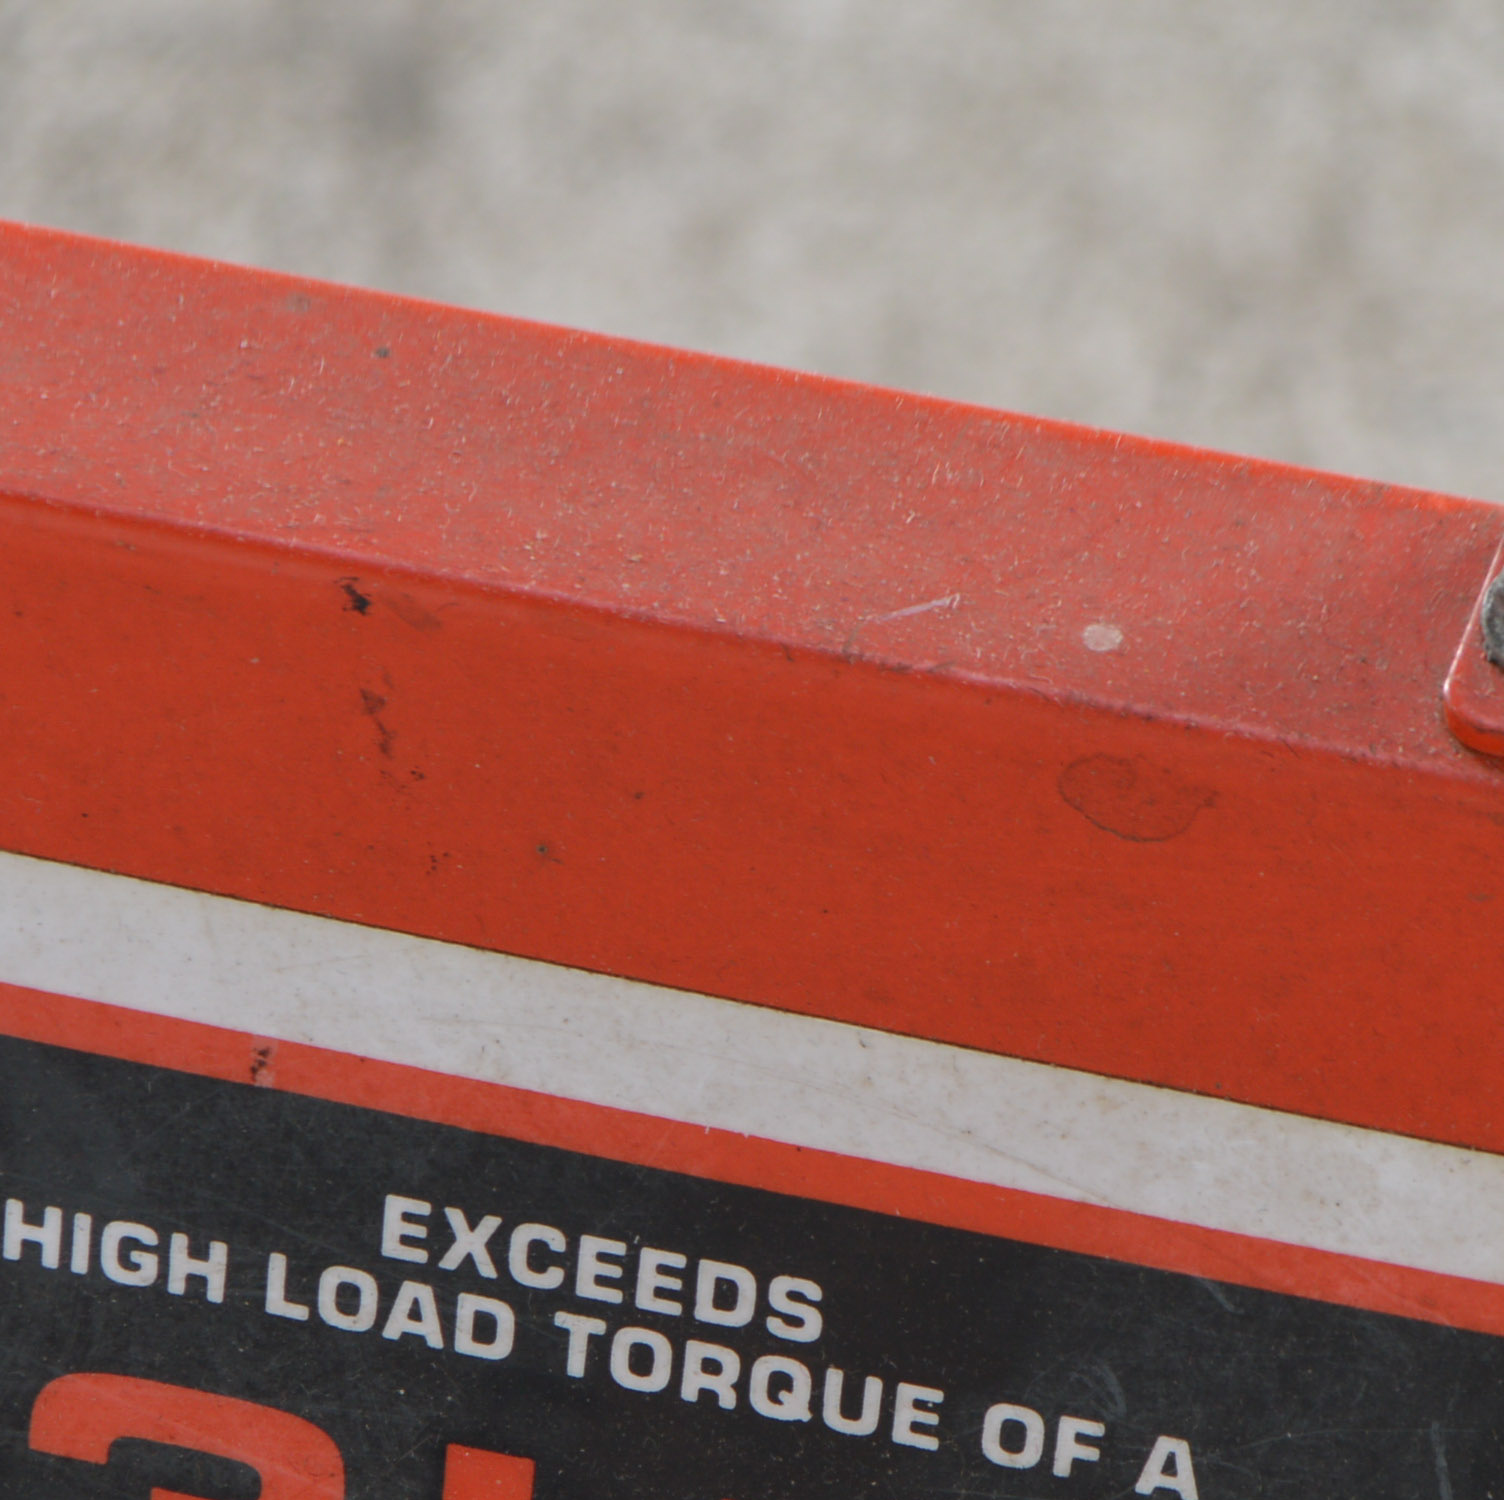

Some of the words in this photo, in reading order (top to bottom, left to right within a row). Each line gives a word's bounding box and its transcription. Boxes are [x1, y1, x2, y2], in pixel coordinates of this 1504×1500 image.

[2, 1197, 229, 1304] HIGH
[264, 1252, 516, 1361] LOAD
[553, 1310, 945, 1452] TORQUE
[980, 1402, 1106, 1478] OF
[380, 1193, 824, 1343] EXCEEDS
